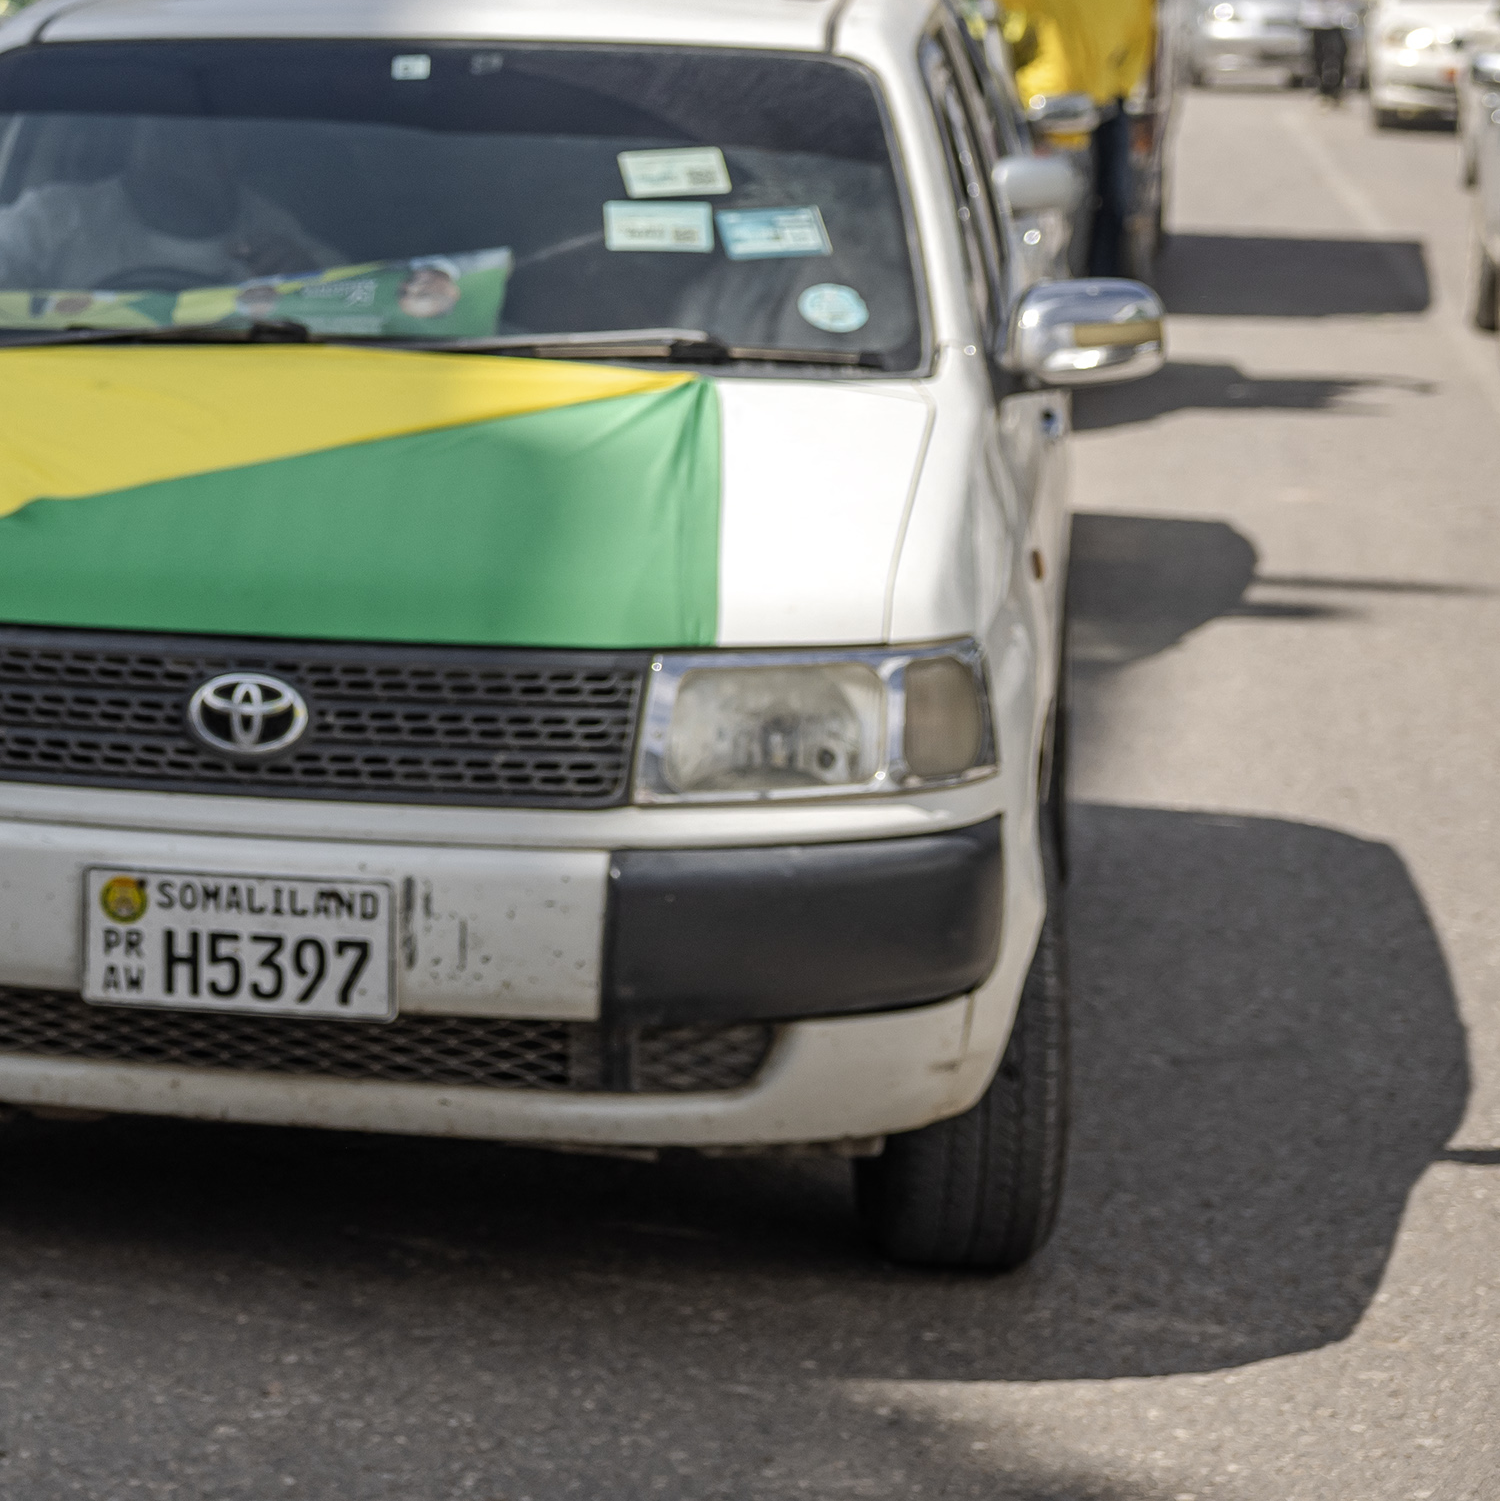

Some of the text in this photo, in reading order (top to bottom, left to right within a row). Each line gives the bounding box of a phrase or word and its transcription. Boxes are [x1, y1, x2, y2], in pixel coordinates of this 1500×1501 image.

[157, 880, 379, 921] SOMALILAND
[103, 929, 144, 957] PR
[164, 930, 371, 1005] H5397
